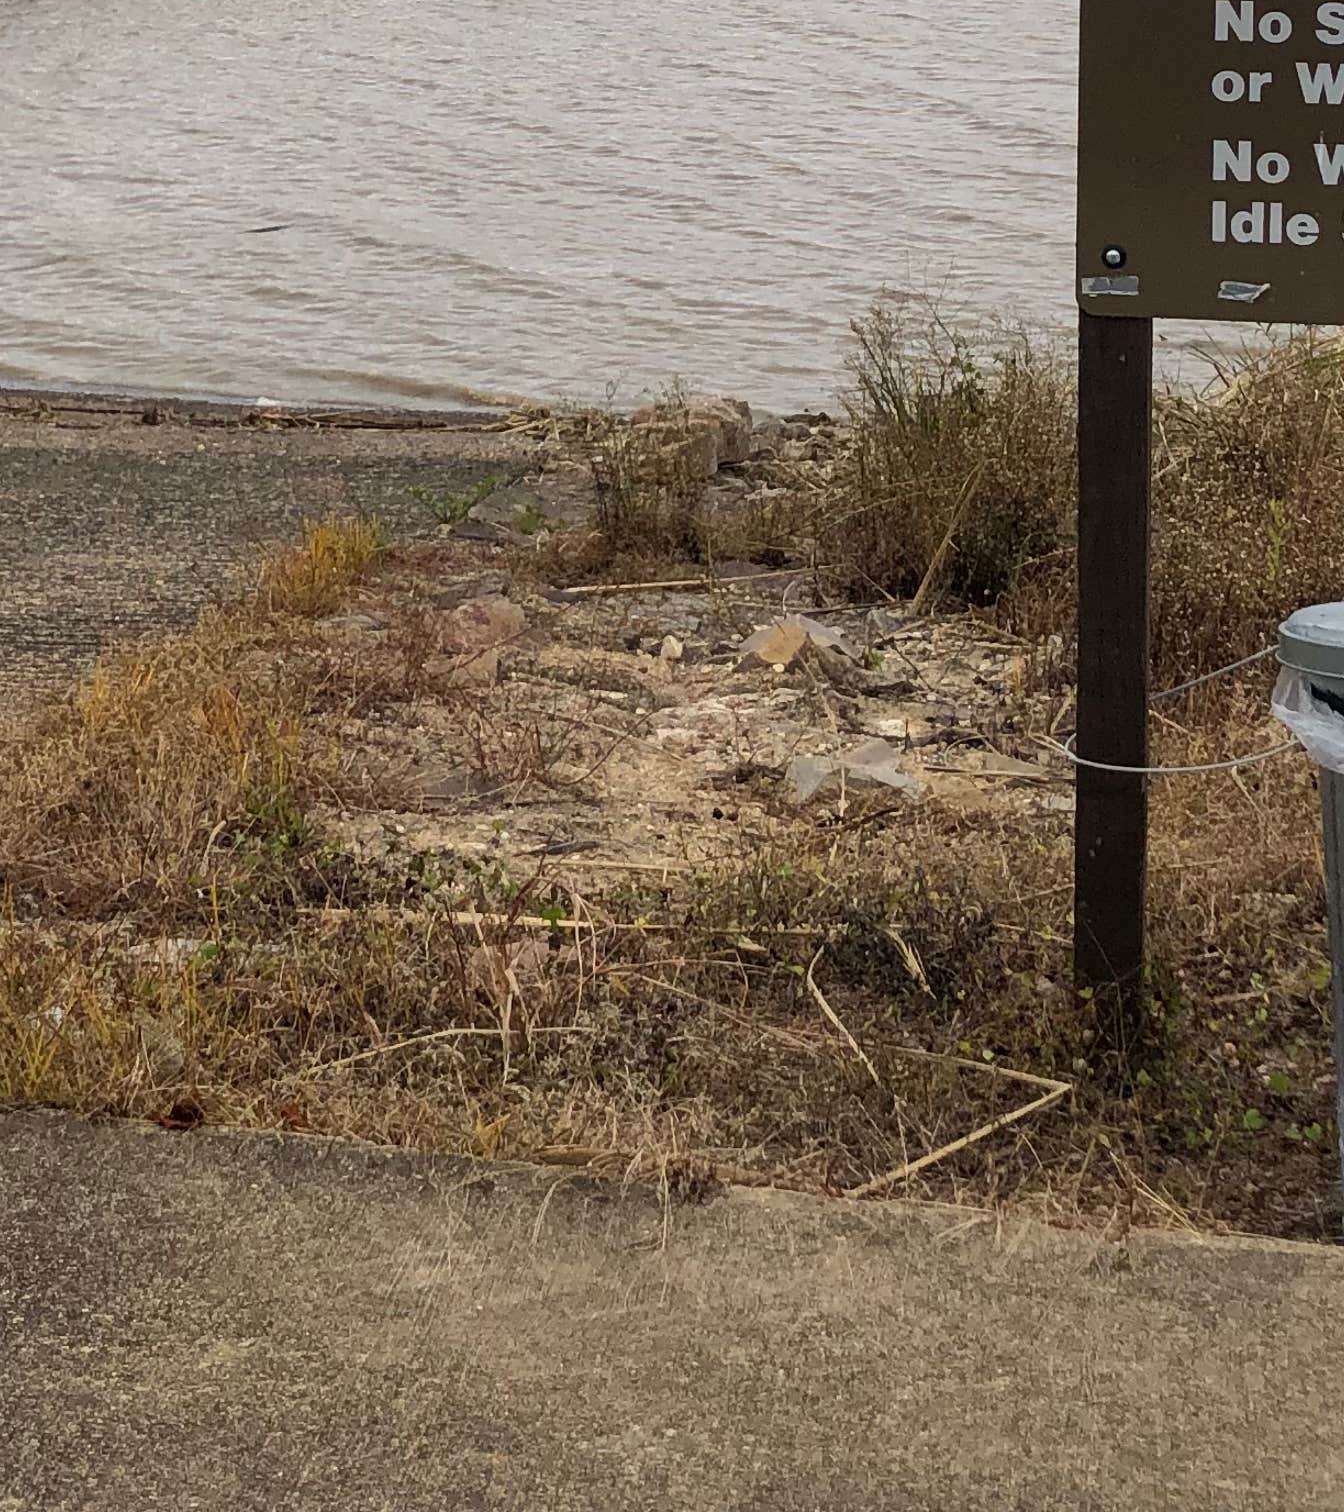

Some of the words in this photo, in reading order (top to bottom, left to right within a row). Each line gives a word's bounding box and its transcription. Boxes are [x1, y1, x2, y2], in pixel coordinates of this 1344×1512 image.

[1214, 0, 1293, 44] No
[1210, 66, 1273, 104] or
[1211, 139, 1291, 185] No
[1211, 199, 1321, 247] Idle
